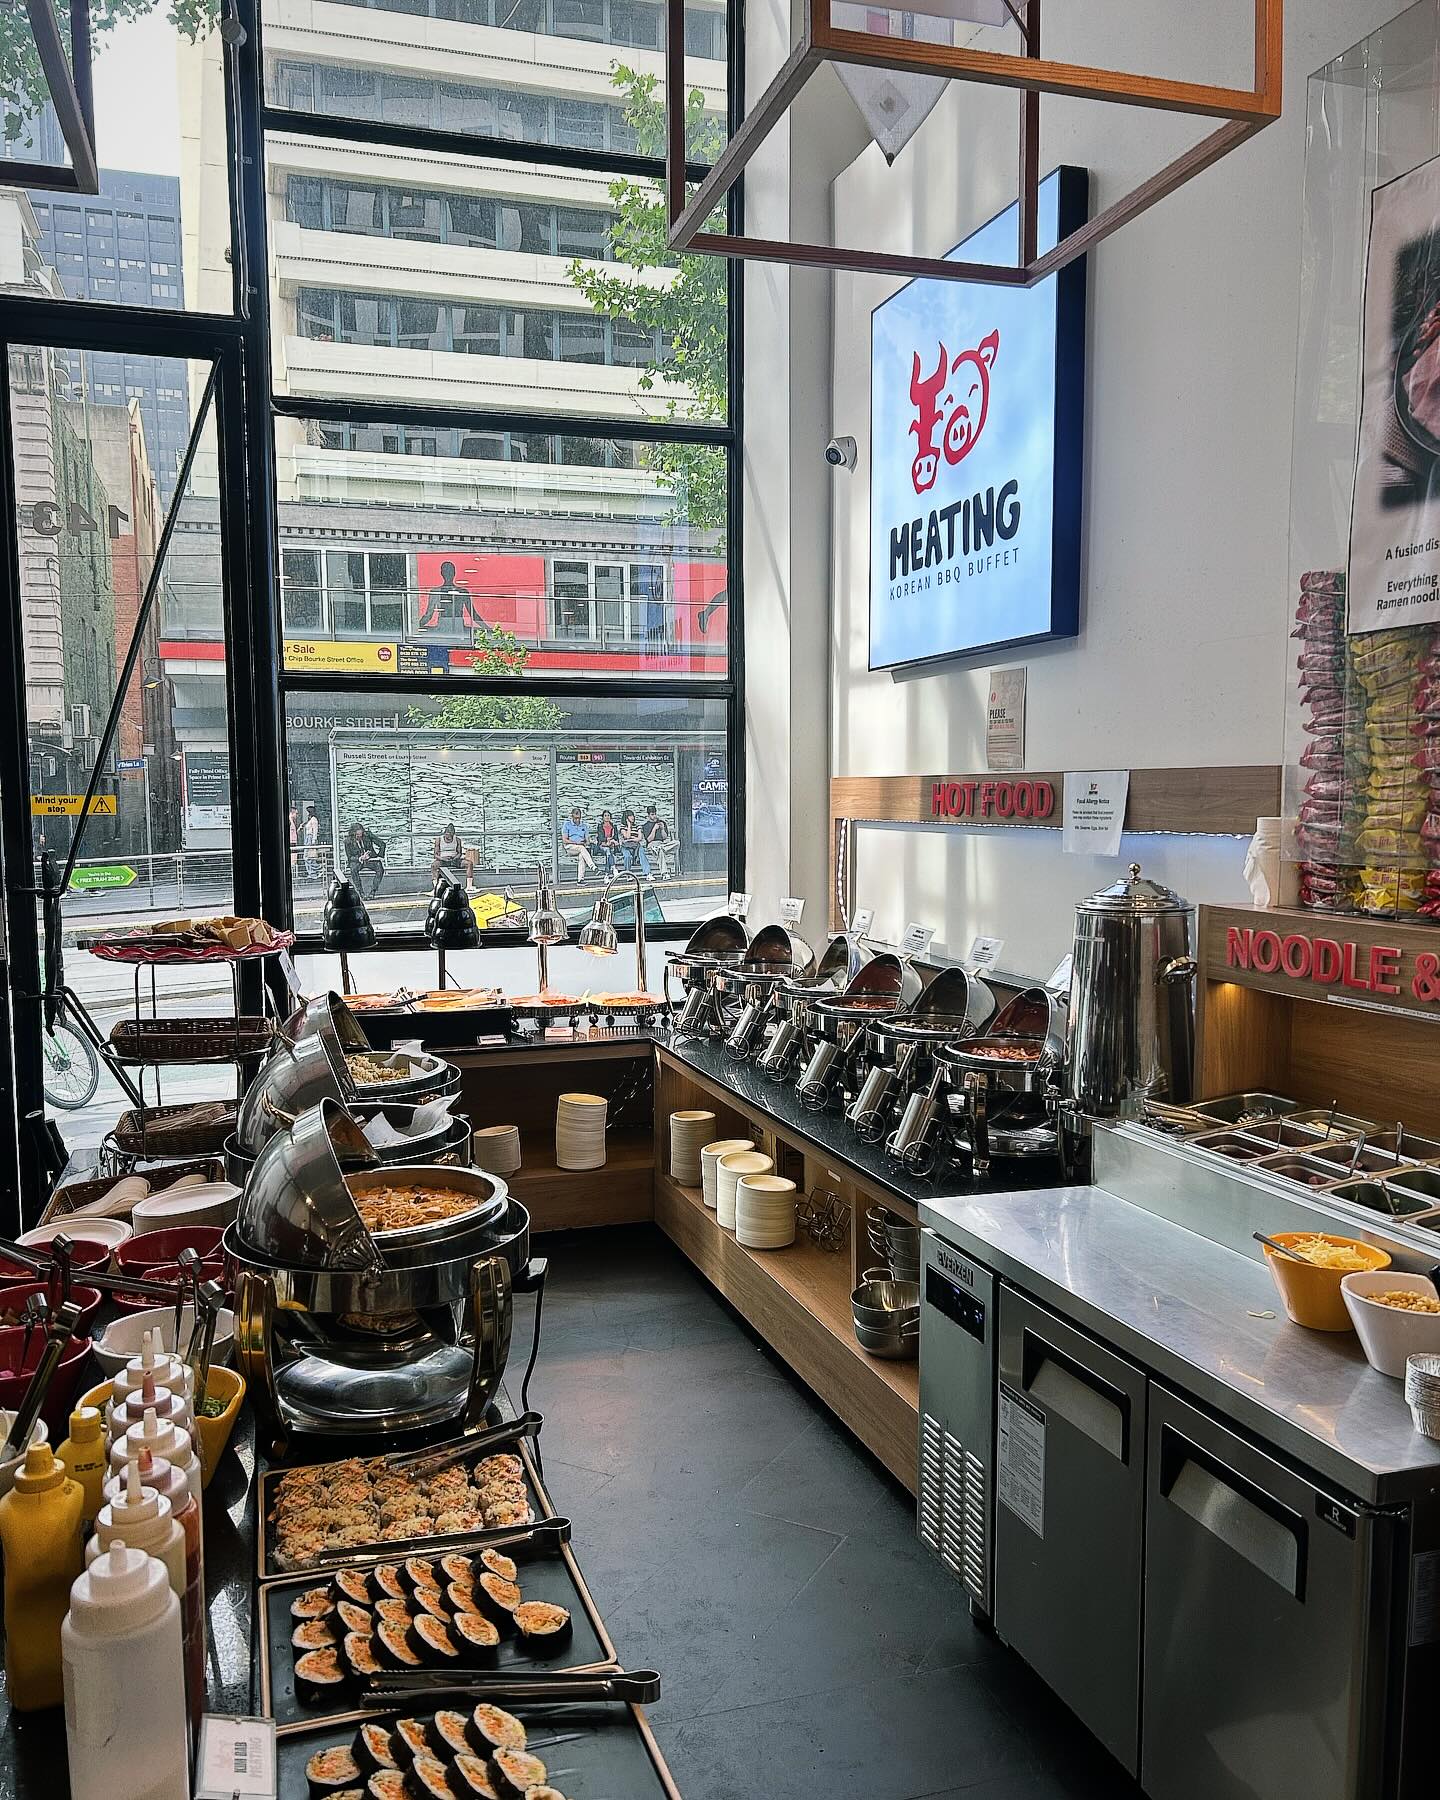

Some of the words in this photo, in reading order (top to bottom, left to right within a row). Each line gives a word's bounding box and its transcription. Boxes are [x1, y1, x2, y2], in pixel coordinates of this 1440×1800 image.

[890, 479, 1021, 581] MEATING
[1385, 548, 1393, 560] A
[1395, 543, 1424, 559] fusion
[889, 575, 931, 601] KOREAN
[937, 566, 961, 586] BBQ
[968, 547, 1019, 576] BUFFET
[1387, 573, 1438, 592] Everything
[1376, 596, 1409, 611] Ramen
[293, 644, 315, 653] Sale
[989, 708, 1006, 719] PLEASE
[286, 717, 342, 728] BOURKE
[34, 796, 56, 804] Mind
[931, 781, 978, 817] HOT
[981, 781, 1055, 817] FOOD
[47, 805, 66, 814] step
[1226, 926, 1402, 994] NOODLE
[1411, 952, 1440, 1001] &
